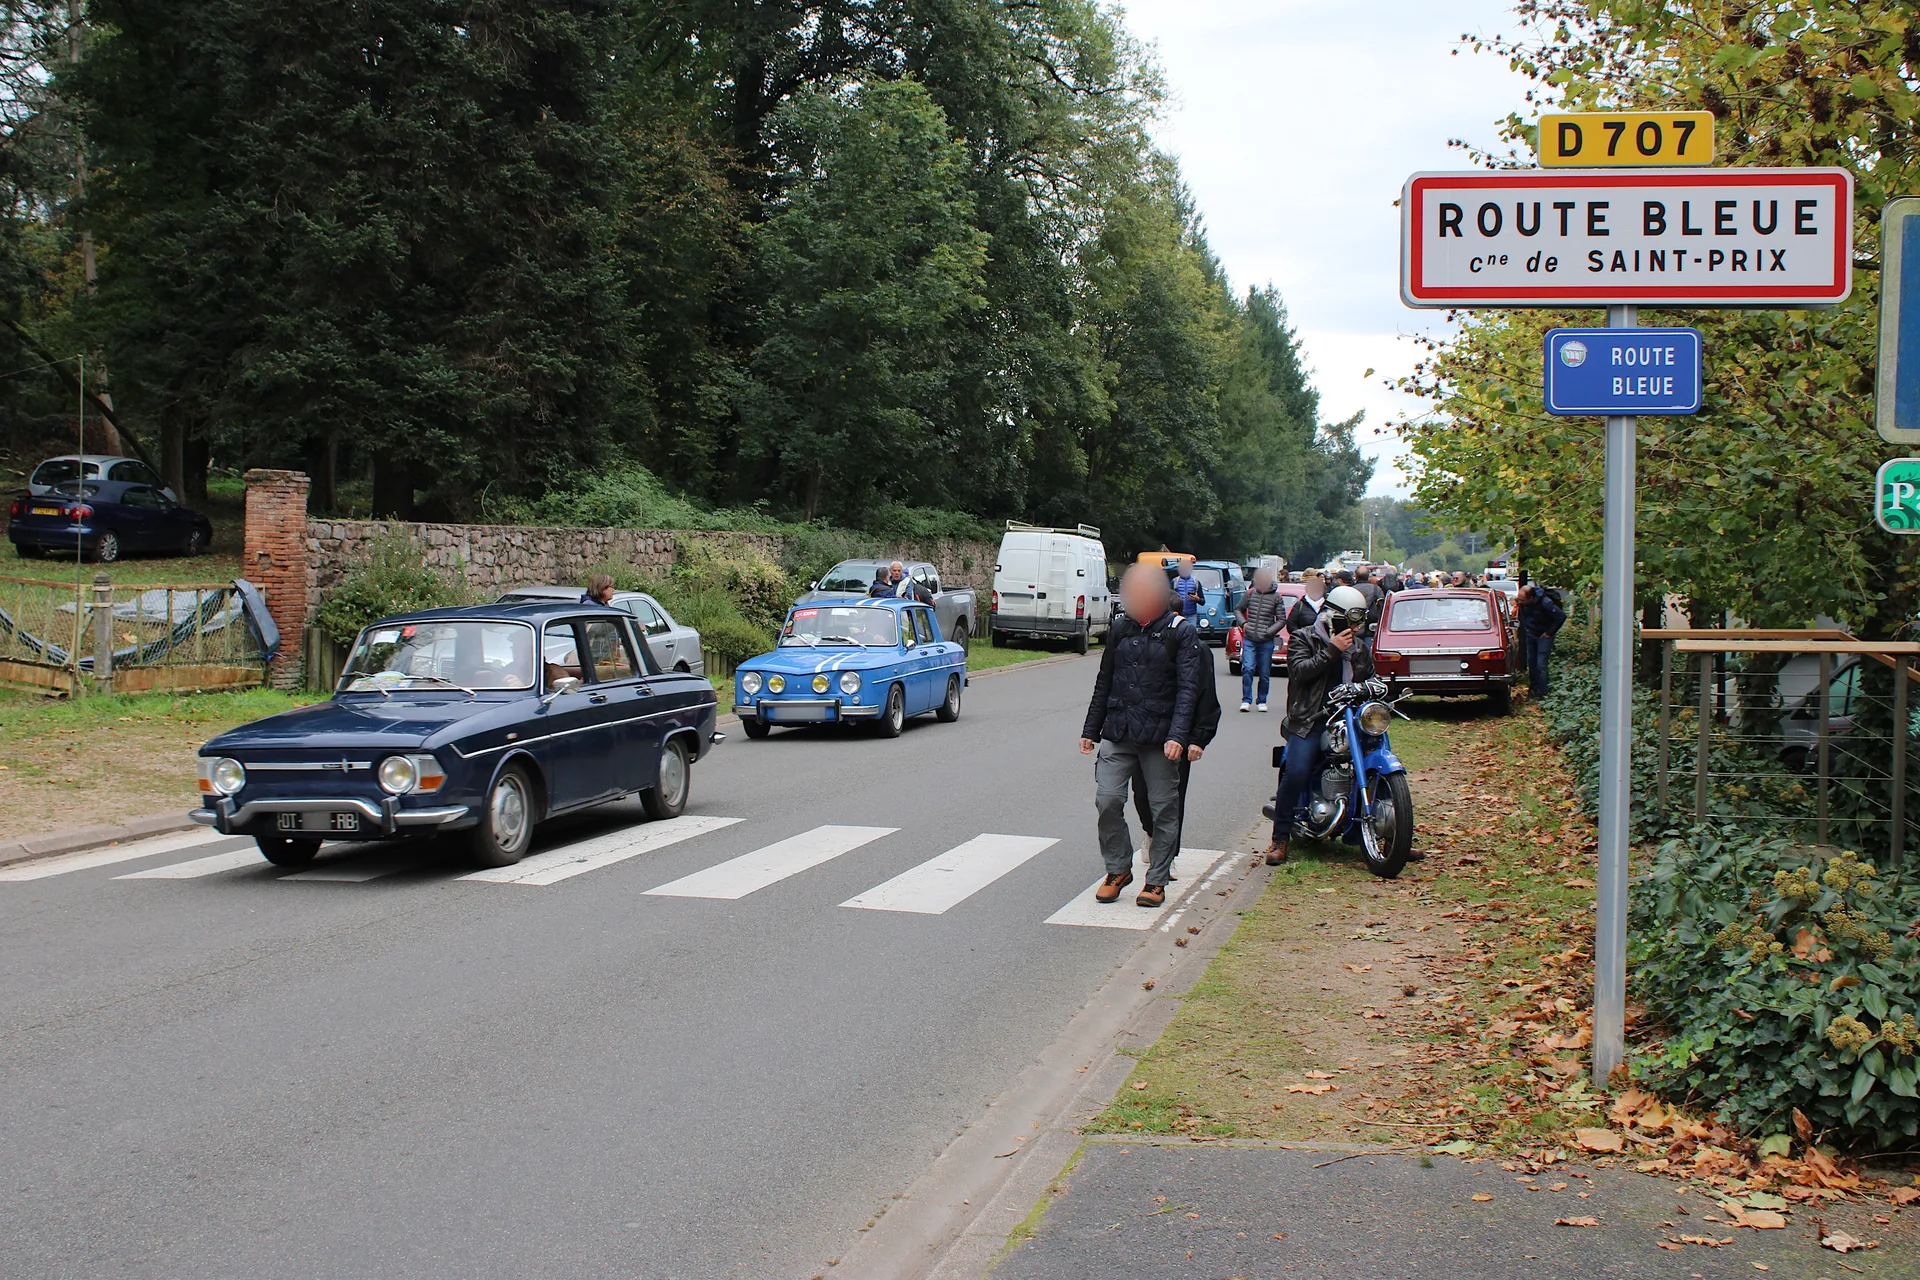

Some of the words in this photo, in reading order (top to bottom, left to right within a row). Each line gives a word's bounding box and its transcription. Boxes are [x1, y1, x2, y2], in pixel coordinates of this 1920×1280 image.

[1558, 122, 1582, 157] D
[1603, 120, 1696, 156] 707
[1439, 201, 1610, 238] ROUTE
[1643, 199, 1818, 236] BLEUE
[1525, 250, 1559, 273] de
[1587, 249, 1787, 273] SAINT-PRIX
[1611, 347, 1675, 366] ROUTE
[1612, 376, 1674, 396] BLEUE
[1888, 482, 1920, 510] P
